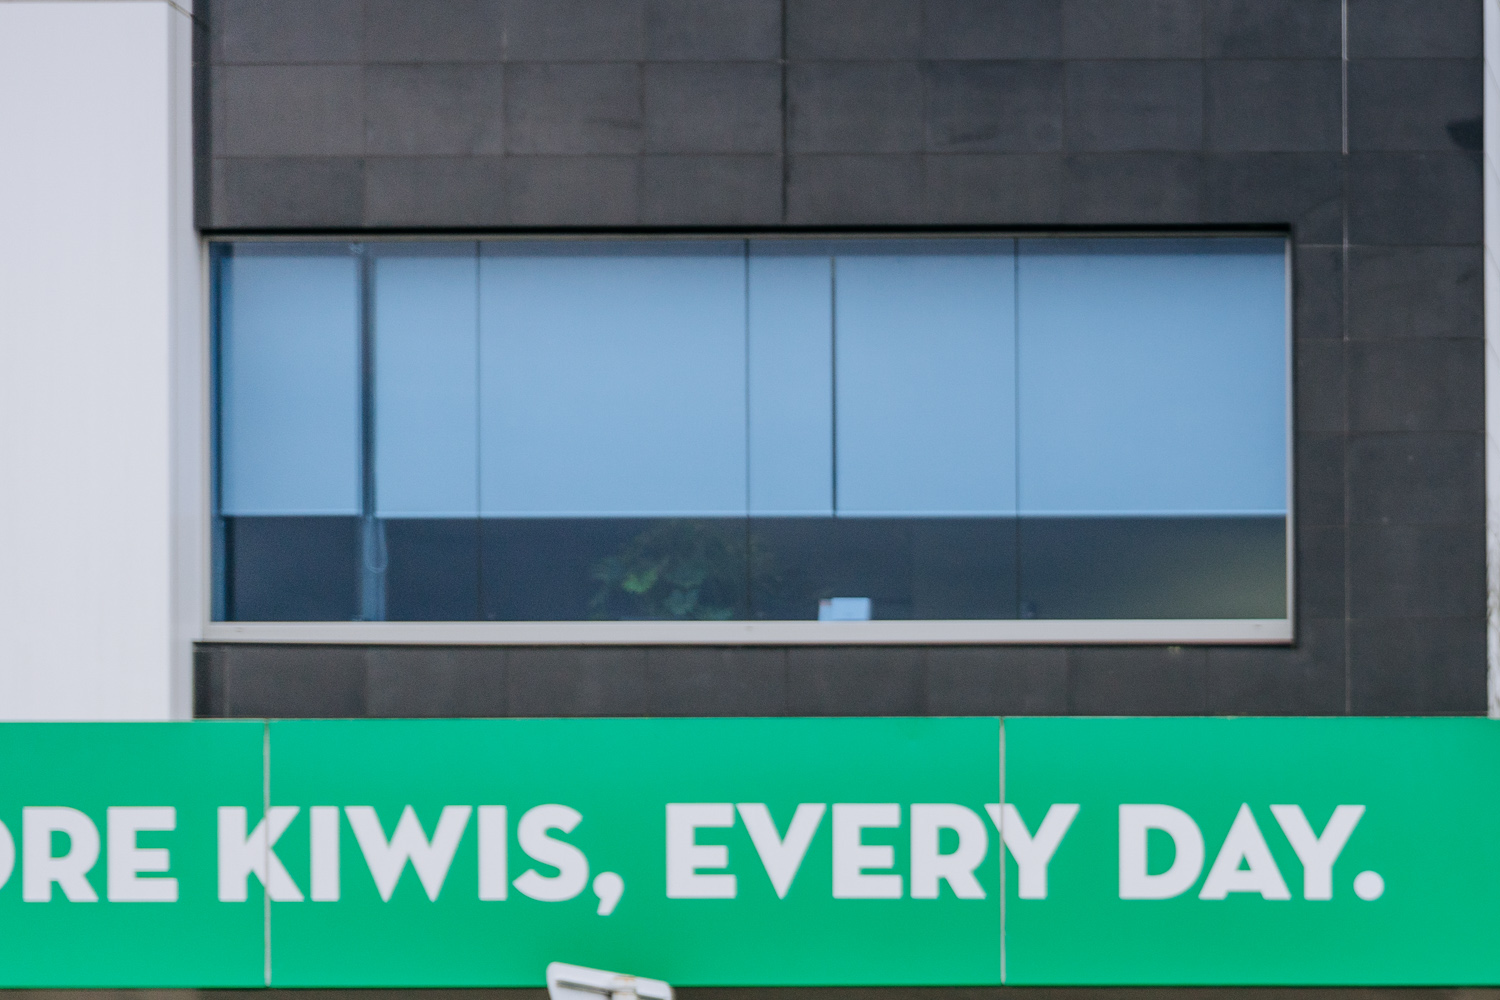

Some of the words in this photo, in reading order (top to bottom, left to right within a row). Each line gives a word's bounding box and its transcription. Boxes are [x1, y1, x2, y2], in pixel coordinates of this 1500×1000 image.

[0, 806, 179, 903] RE
[217, 803, 625, 917] KIWIS,
[665, 802, 1080, 900] EVERY
[1118, 803, 1386, 902] DAY.
